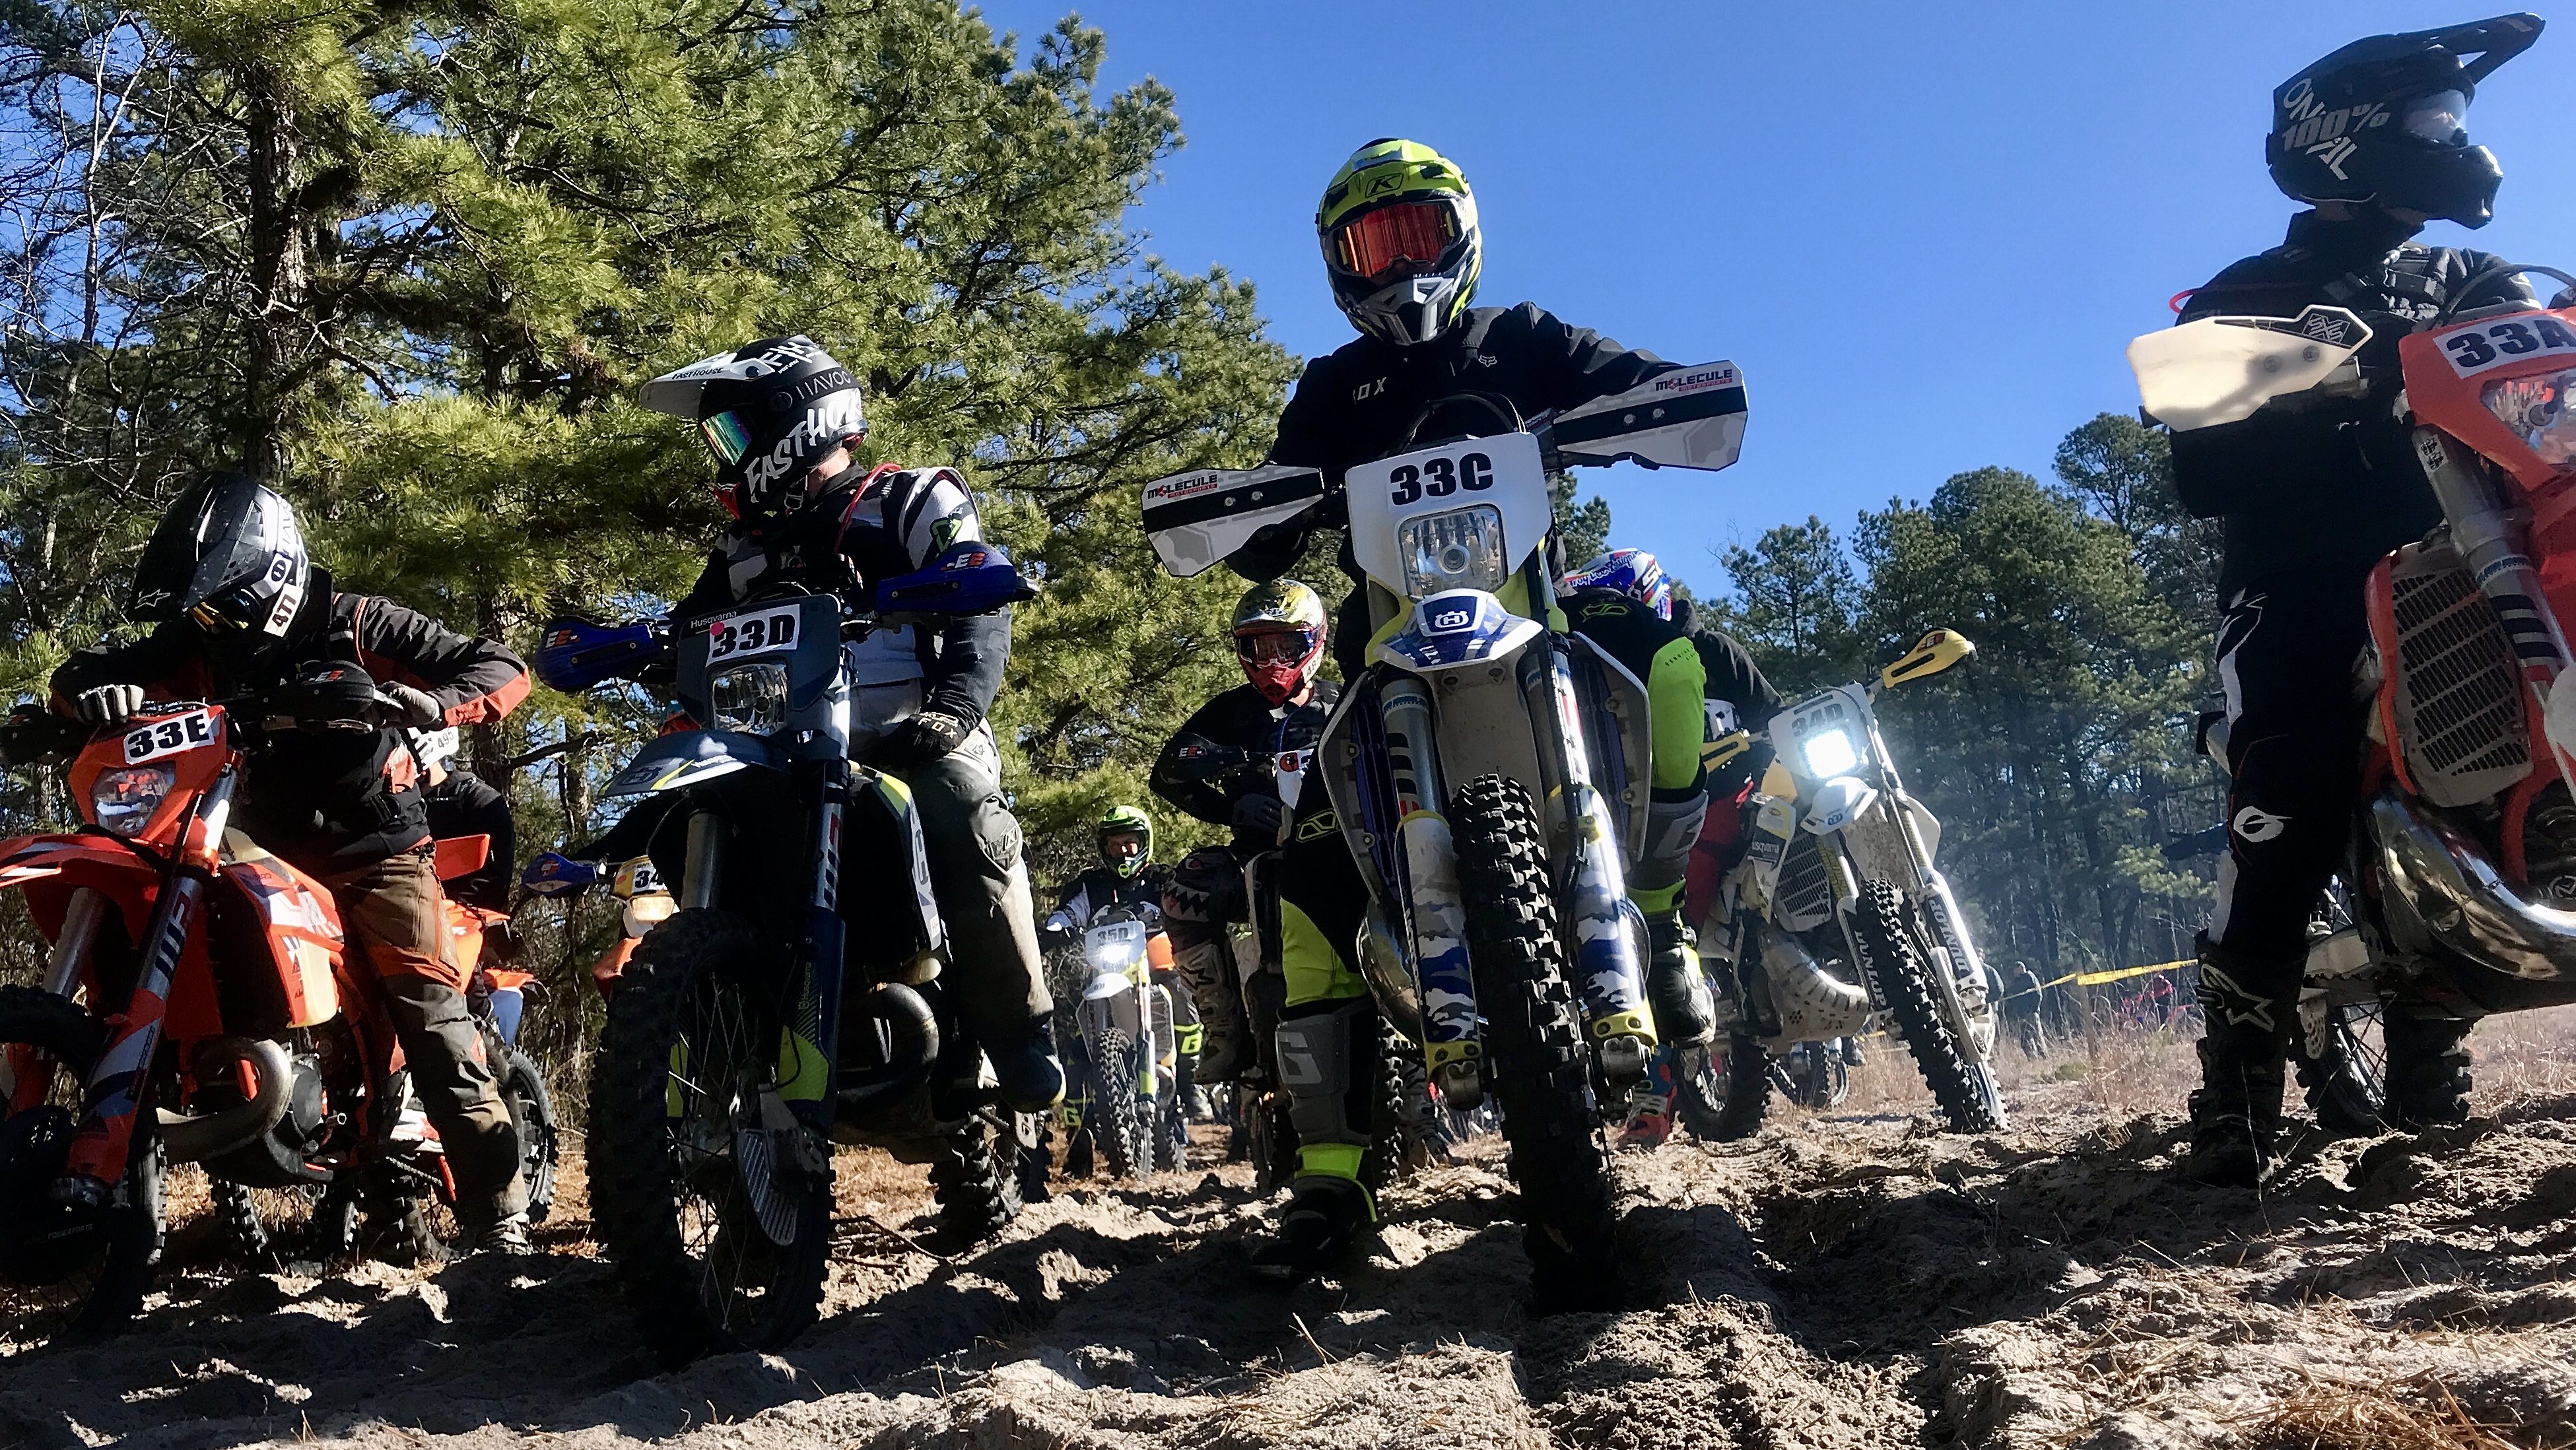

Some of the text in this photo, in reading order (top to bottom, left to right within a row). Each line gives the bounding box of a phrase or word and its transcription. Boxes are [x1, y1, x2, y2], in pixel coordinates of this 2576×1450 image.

[2282, 102, 2391, 151] 100%
[2446, 320, 2576, 368] 33A
[672, 367, 724, 379] FASTHOUSE
[1353, 377, 1386, 405] OX
[1390, 453, 1493, 506] 33C
[691, 610, 737, 628] Husqvarna
[712, 614, 795, 658] 33D
[128, 713, 209, 758] 33E
[918, 717, 957, 739] FOX
[1792, 704, 1844, 737] 34D
[1098, 927, 1128, 946] 35D
[1928, 899, 1970, 972] DUNLOP
